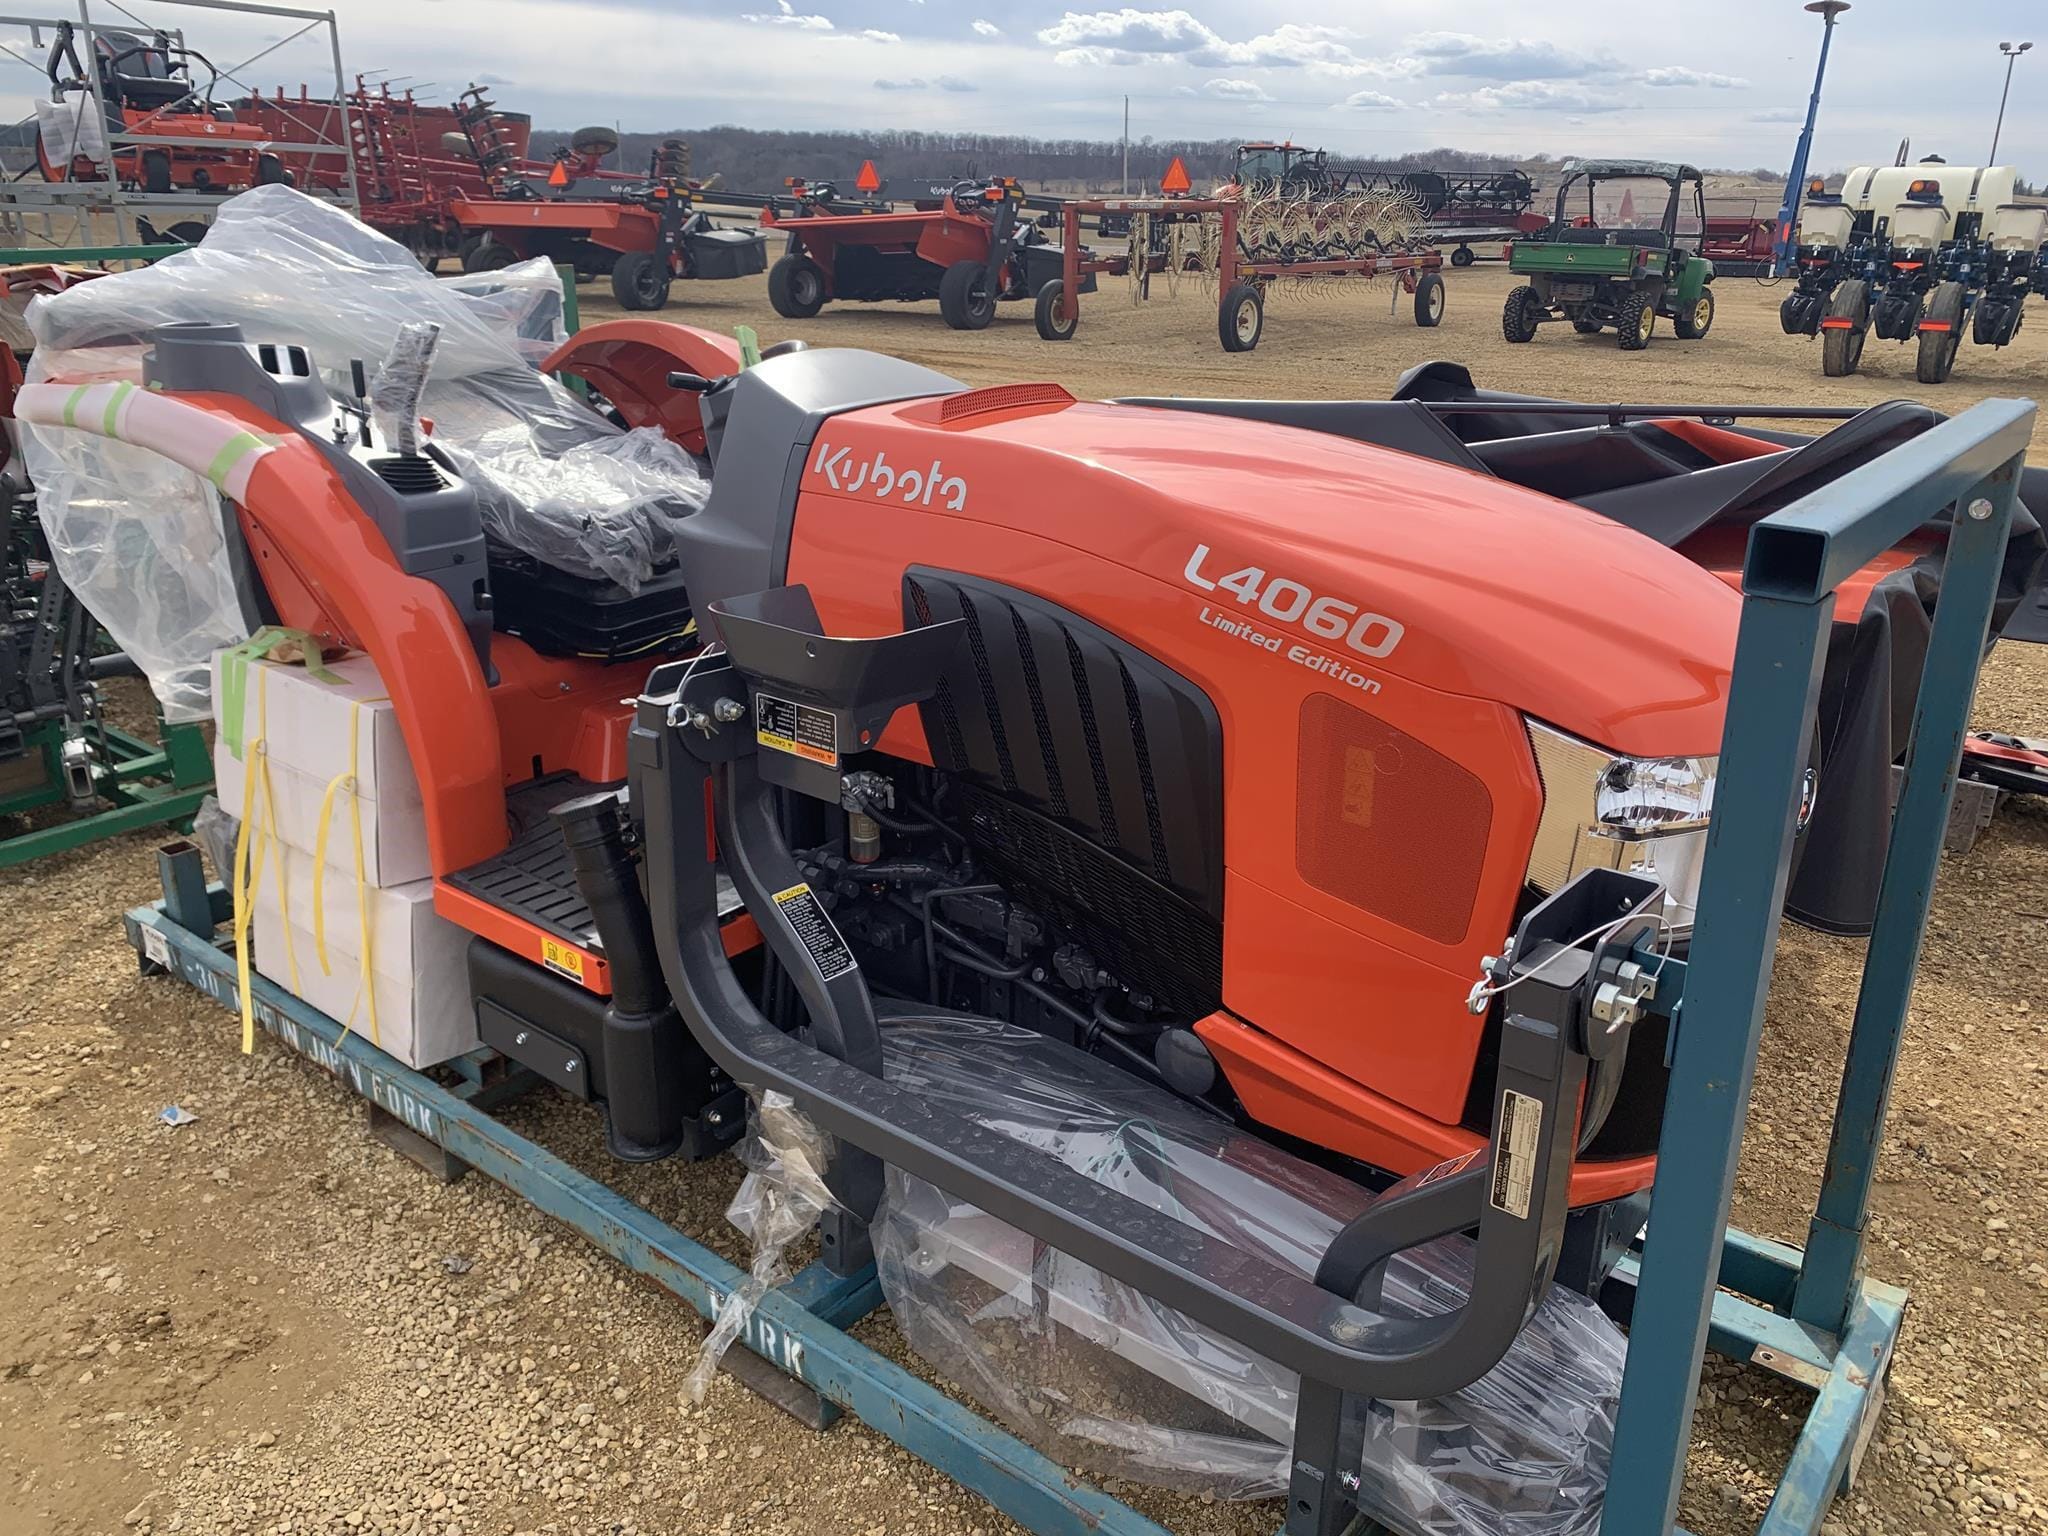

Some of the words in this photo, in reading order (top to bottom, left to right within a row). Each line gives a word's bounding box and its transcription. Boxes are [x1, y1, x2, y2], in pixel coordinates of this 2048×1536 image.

[930, 185, 958, 196] Kubot
[814, 443, 967, 511] Kubota
[1184, 544, 1405, 658] L4060
[1199, 607, 1283, 653] Limited
[1287, 645, 1382, 694] Edition
[780, 885, 806, 898] CAUTION
[371, 1072, 433, 1136] FORK
